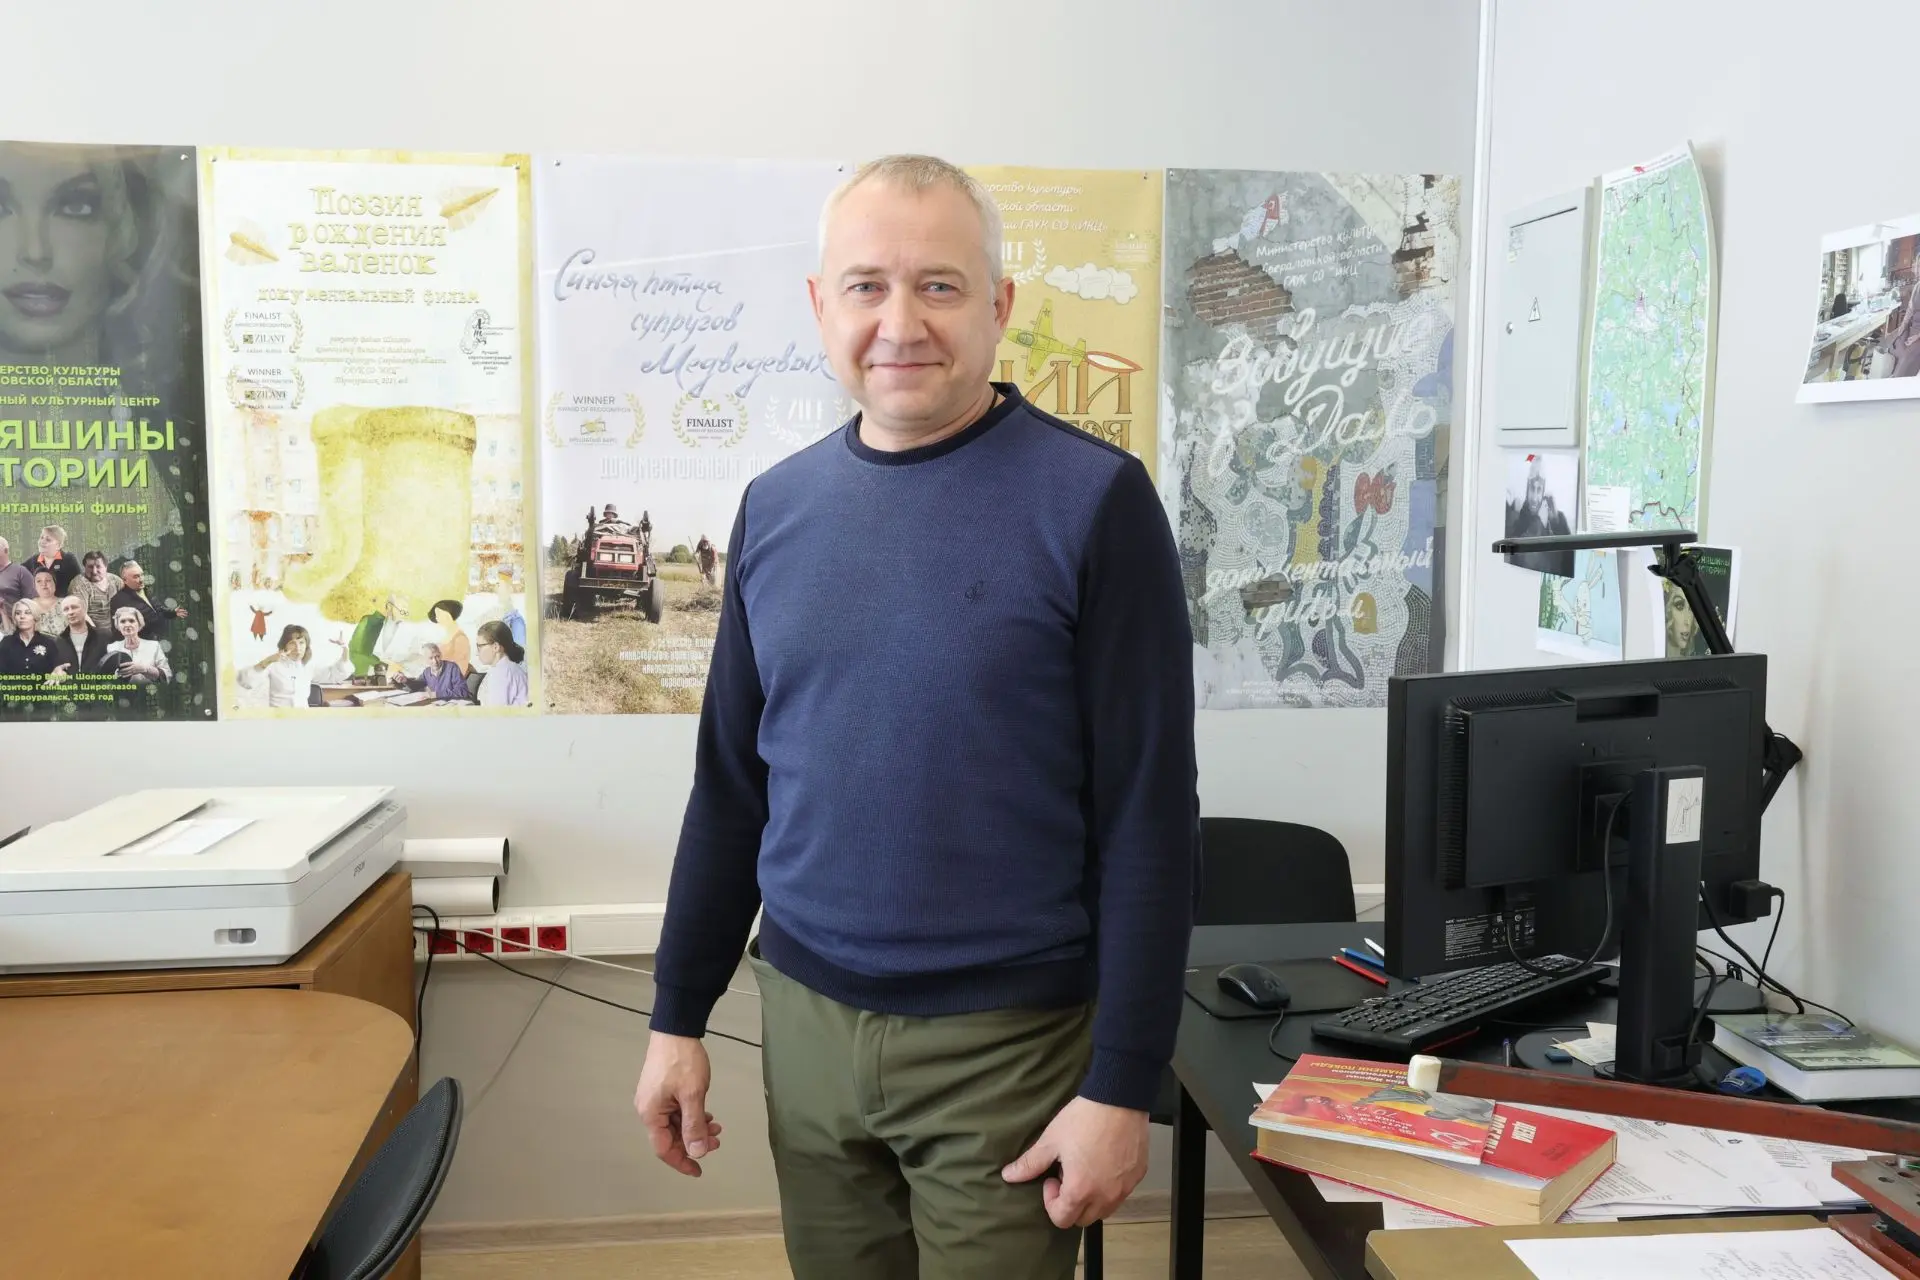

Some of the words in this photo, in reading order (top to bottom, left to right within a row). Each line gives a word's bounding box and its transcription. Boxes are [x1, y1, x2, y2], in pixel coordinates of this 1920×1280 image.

[308, 185, 423, 217] Поэзия
[286, 222, 447, 250] рождения
[1256, 235, 1333, 258] Министерство
[299, 251, 438, 275] валенок
[554, 248, 638, 301] Синяя
[641, 270, 724, 312] птица
[256, 287, 415, 305] документальный
[423, 288, 480, 306] фильм
[244, 312, 281, 320] FINALIST
[631, 302, 744, 342] супругов
[254, 334, 286, 343] ZILANT
[0, 366, 49, 376] ЕРСТВО
[53, 366, 121, 376] КУЛЬТУРЫ
[640, 341, 837, 398] Медведевых
[1, 375, 54, 386] ОВСКОЙ
[58, 377, 119, 386] ОБЛАСТИ
[0, 393, 27, 405] НЫЙ
[31, 393, 116, 406] КУЛЬТУРНЫЙ
[120, 397, 161, 407] ЦЕНТР
[256, 390, 287, 400] ZILANT
[573, 395, 616, 405] WINNER
[686, 418, 734, 428] FINALIST
[0, 420, 175, 450] ЯШИНЫ
[0, 457, 149, 488] ТОРИИ
[1, 501, 85, 514] нтальный
[91, 501, 148, 515] фильм
[0, 673, 42, 683] режиссёр
[76, 673, 118, 681] Шолохов
[36, 682, 78, 692] Геннадий
[81, 683, 137, 692] Широглазов
[3, 693, 71, 703] Первоуральск,
[73, 693, 96, 701] 2026
[98, 694, 114, 702] год
[1310, 1061, 1356, 1071] ПОБЕДЫ
